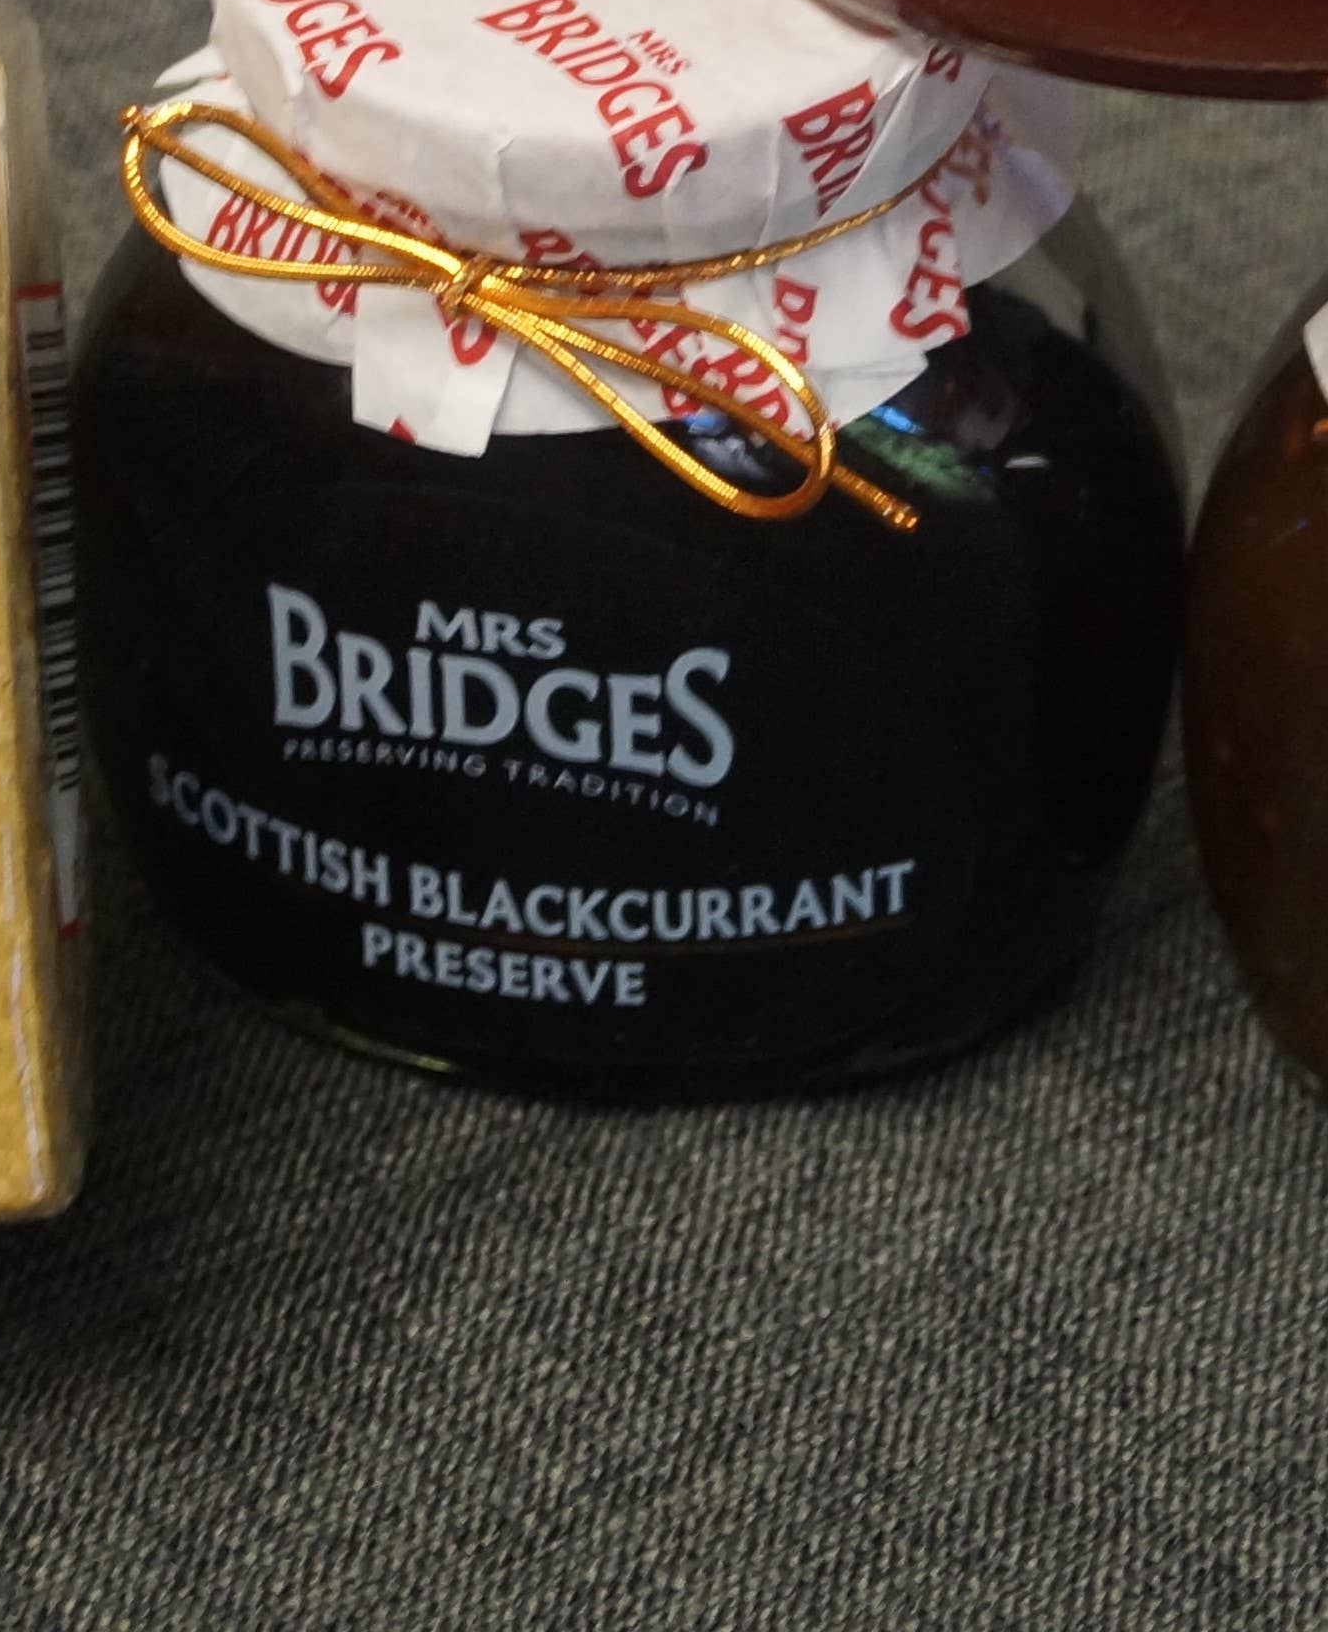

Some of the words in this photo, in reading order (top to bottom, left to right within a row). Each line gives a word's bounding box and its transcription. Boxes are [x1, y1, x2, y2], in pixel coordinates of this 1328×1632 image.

[627, 27, 694, 77] MRS
[415, 600, 567, 660] MRS
[267, 582, 736, 788] BRIDGES
[283, 737, 487, 778] PRESERVING
[504, 760, 722, 828] TRADITION
[148, 751, 391, 907] SCOTTISH
[407, 859, 917, 943] BLACKCURRANT
[361, 922, 649, 1008] PRESERVE
